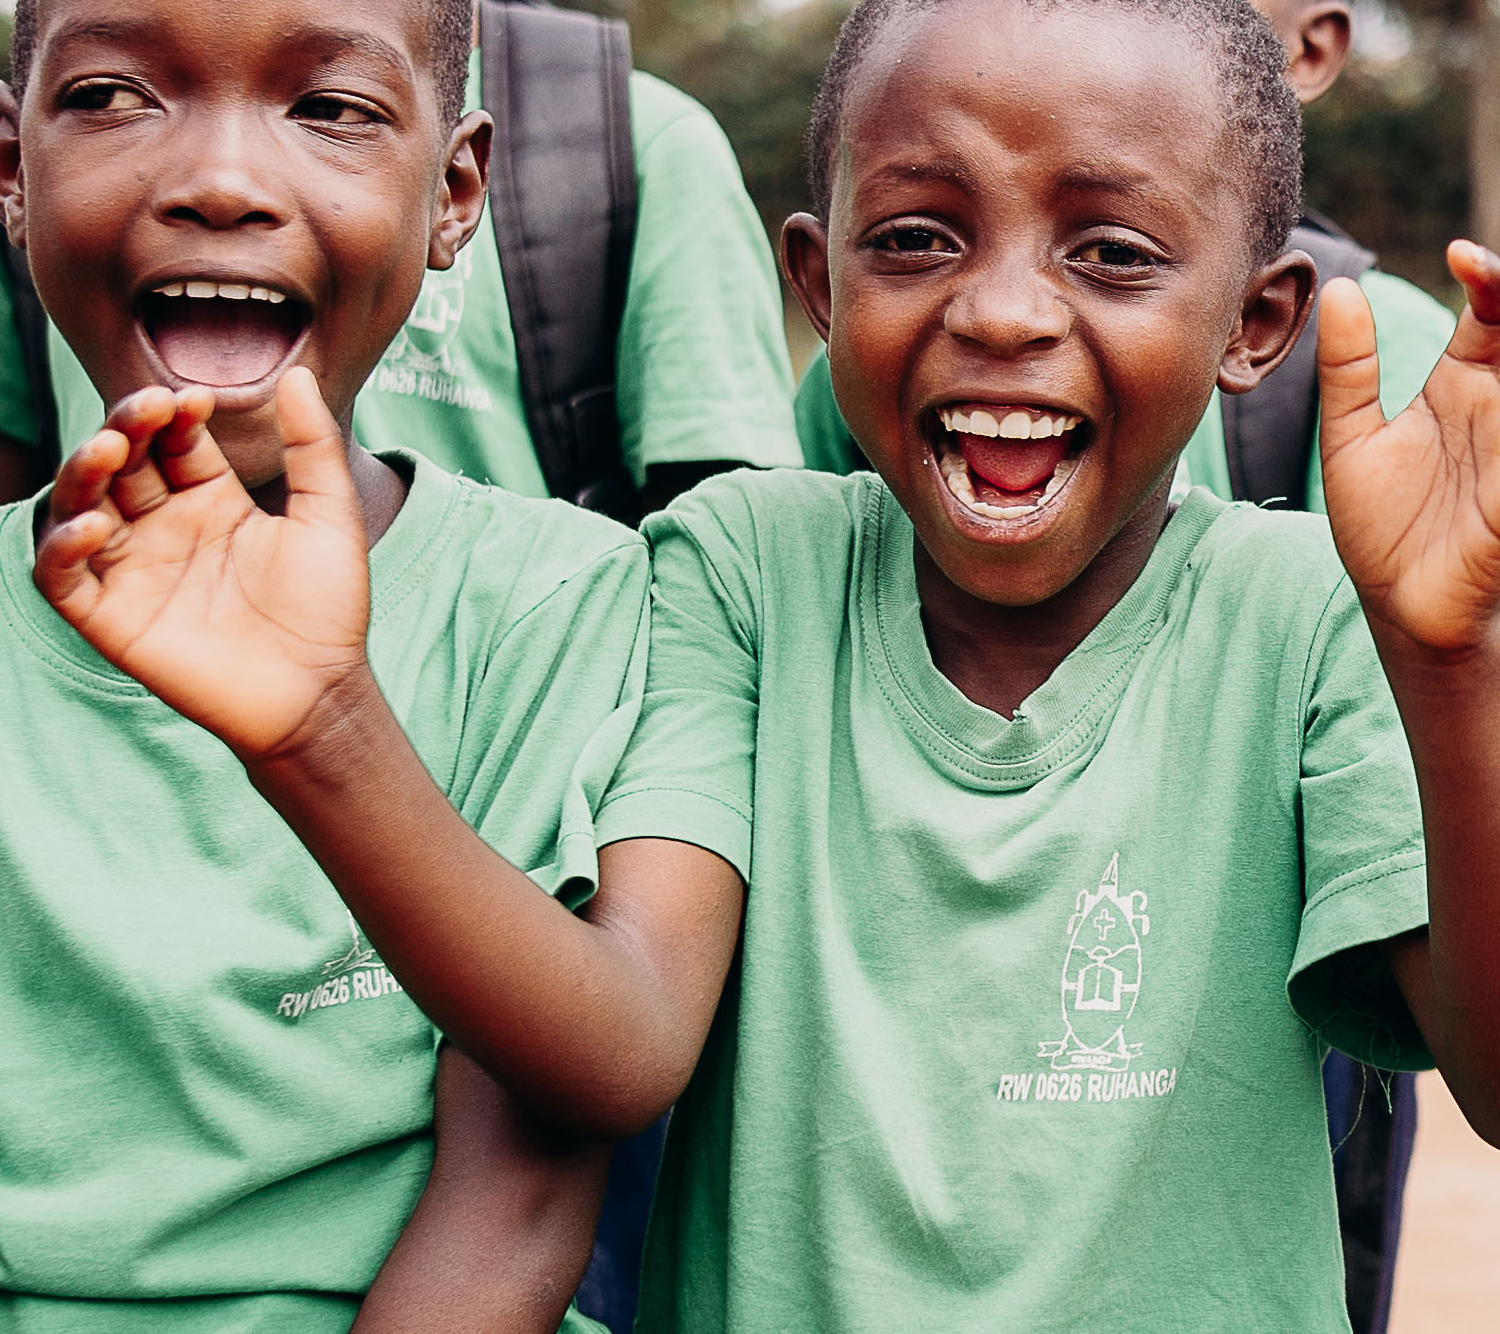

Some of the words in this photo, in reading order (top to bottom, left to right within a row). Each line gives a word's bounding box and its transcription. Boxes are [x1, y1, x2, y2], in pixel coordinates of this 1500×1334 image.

[275, 989, 313, 1018] RW
[309, 975, 350, 1010] 0626
[351, 967, 404, 1000] RUH
[997, 1073, 1033, 1102] RW
[1035, 1073, 1083, 1102] 0626
[1087, 1067, 1177, 1102] RUHANGA
